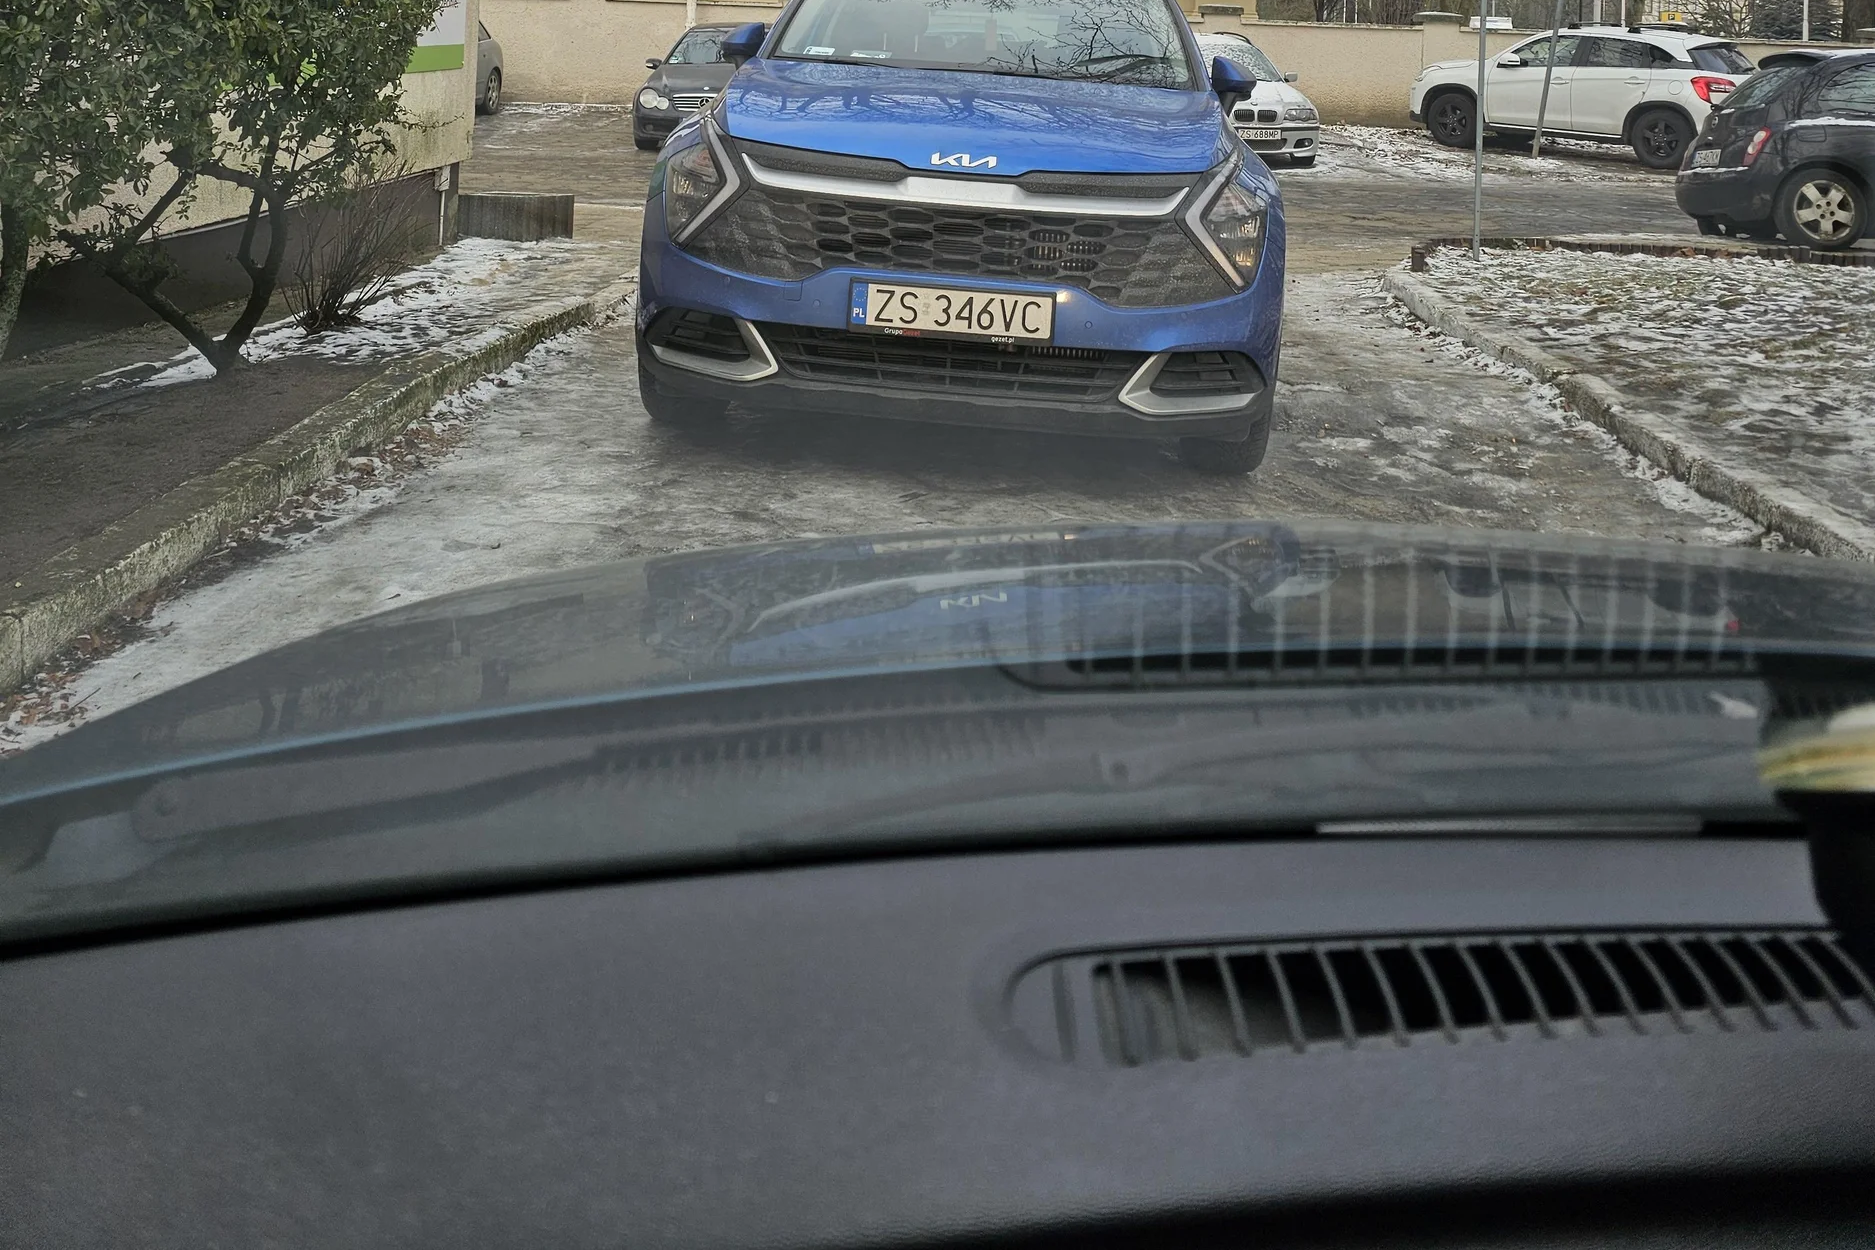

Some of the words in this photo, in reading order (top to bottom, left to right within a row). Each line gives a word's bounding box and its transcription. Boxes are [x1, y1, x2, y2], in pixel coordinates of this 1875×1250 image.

[930, 152, 998, 169] KIA
[853, 307, 865, 318] PL
[874, 289, 919, 325] ZS
[933, 294, 1042, 334] 346VC
